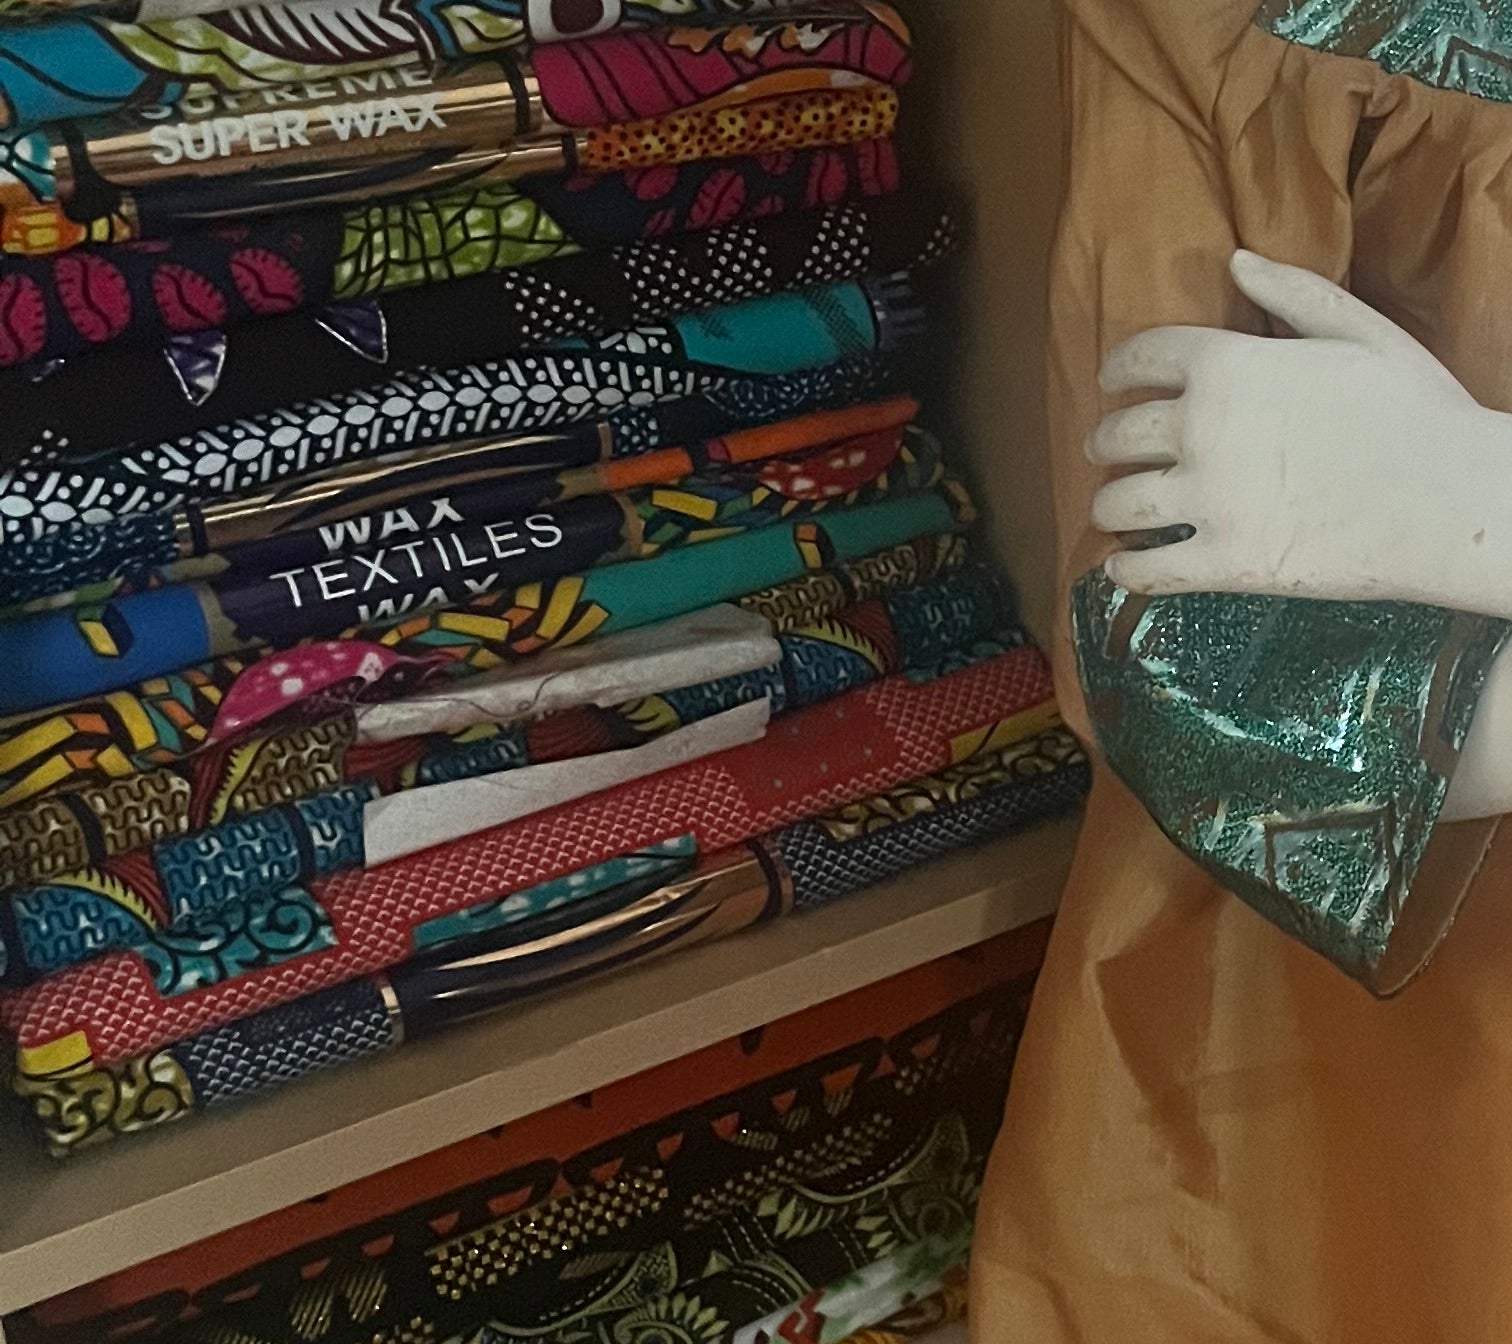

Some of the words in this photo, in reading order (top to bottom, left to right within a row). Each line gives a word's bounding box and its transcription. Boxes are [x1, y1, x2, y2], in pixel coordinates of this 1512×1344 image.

[150, 109, 311, 165] SUPER
[320, 91, 446, 142] WAX
[269, 513, 562, 608] TEXTILES
[318, 497, 465, 552] WAX
